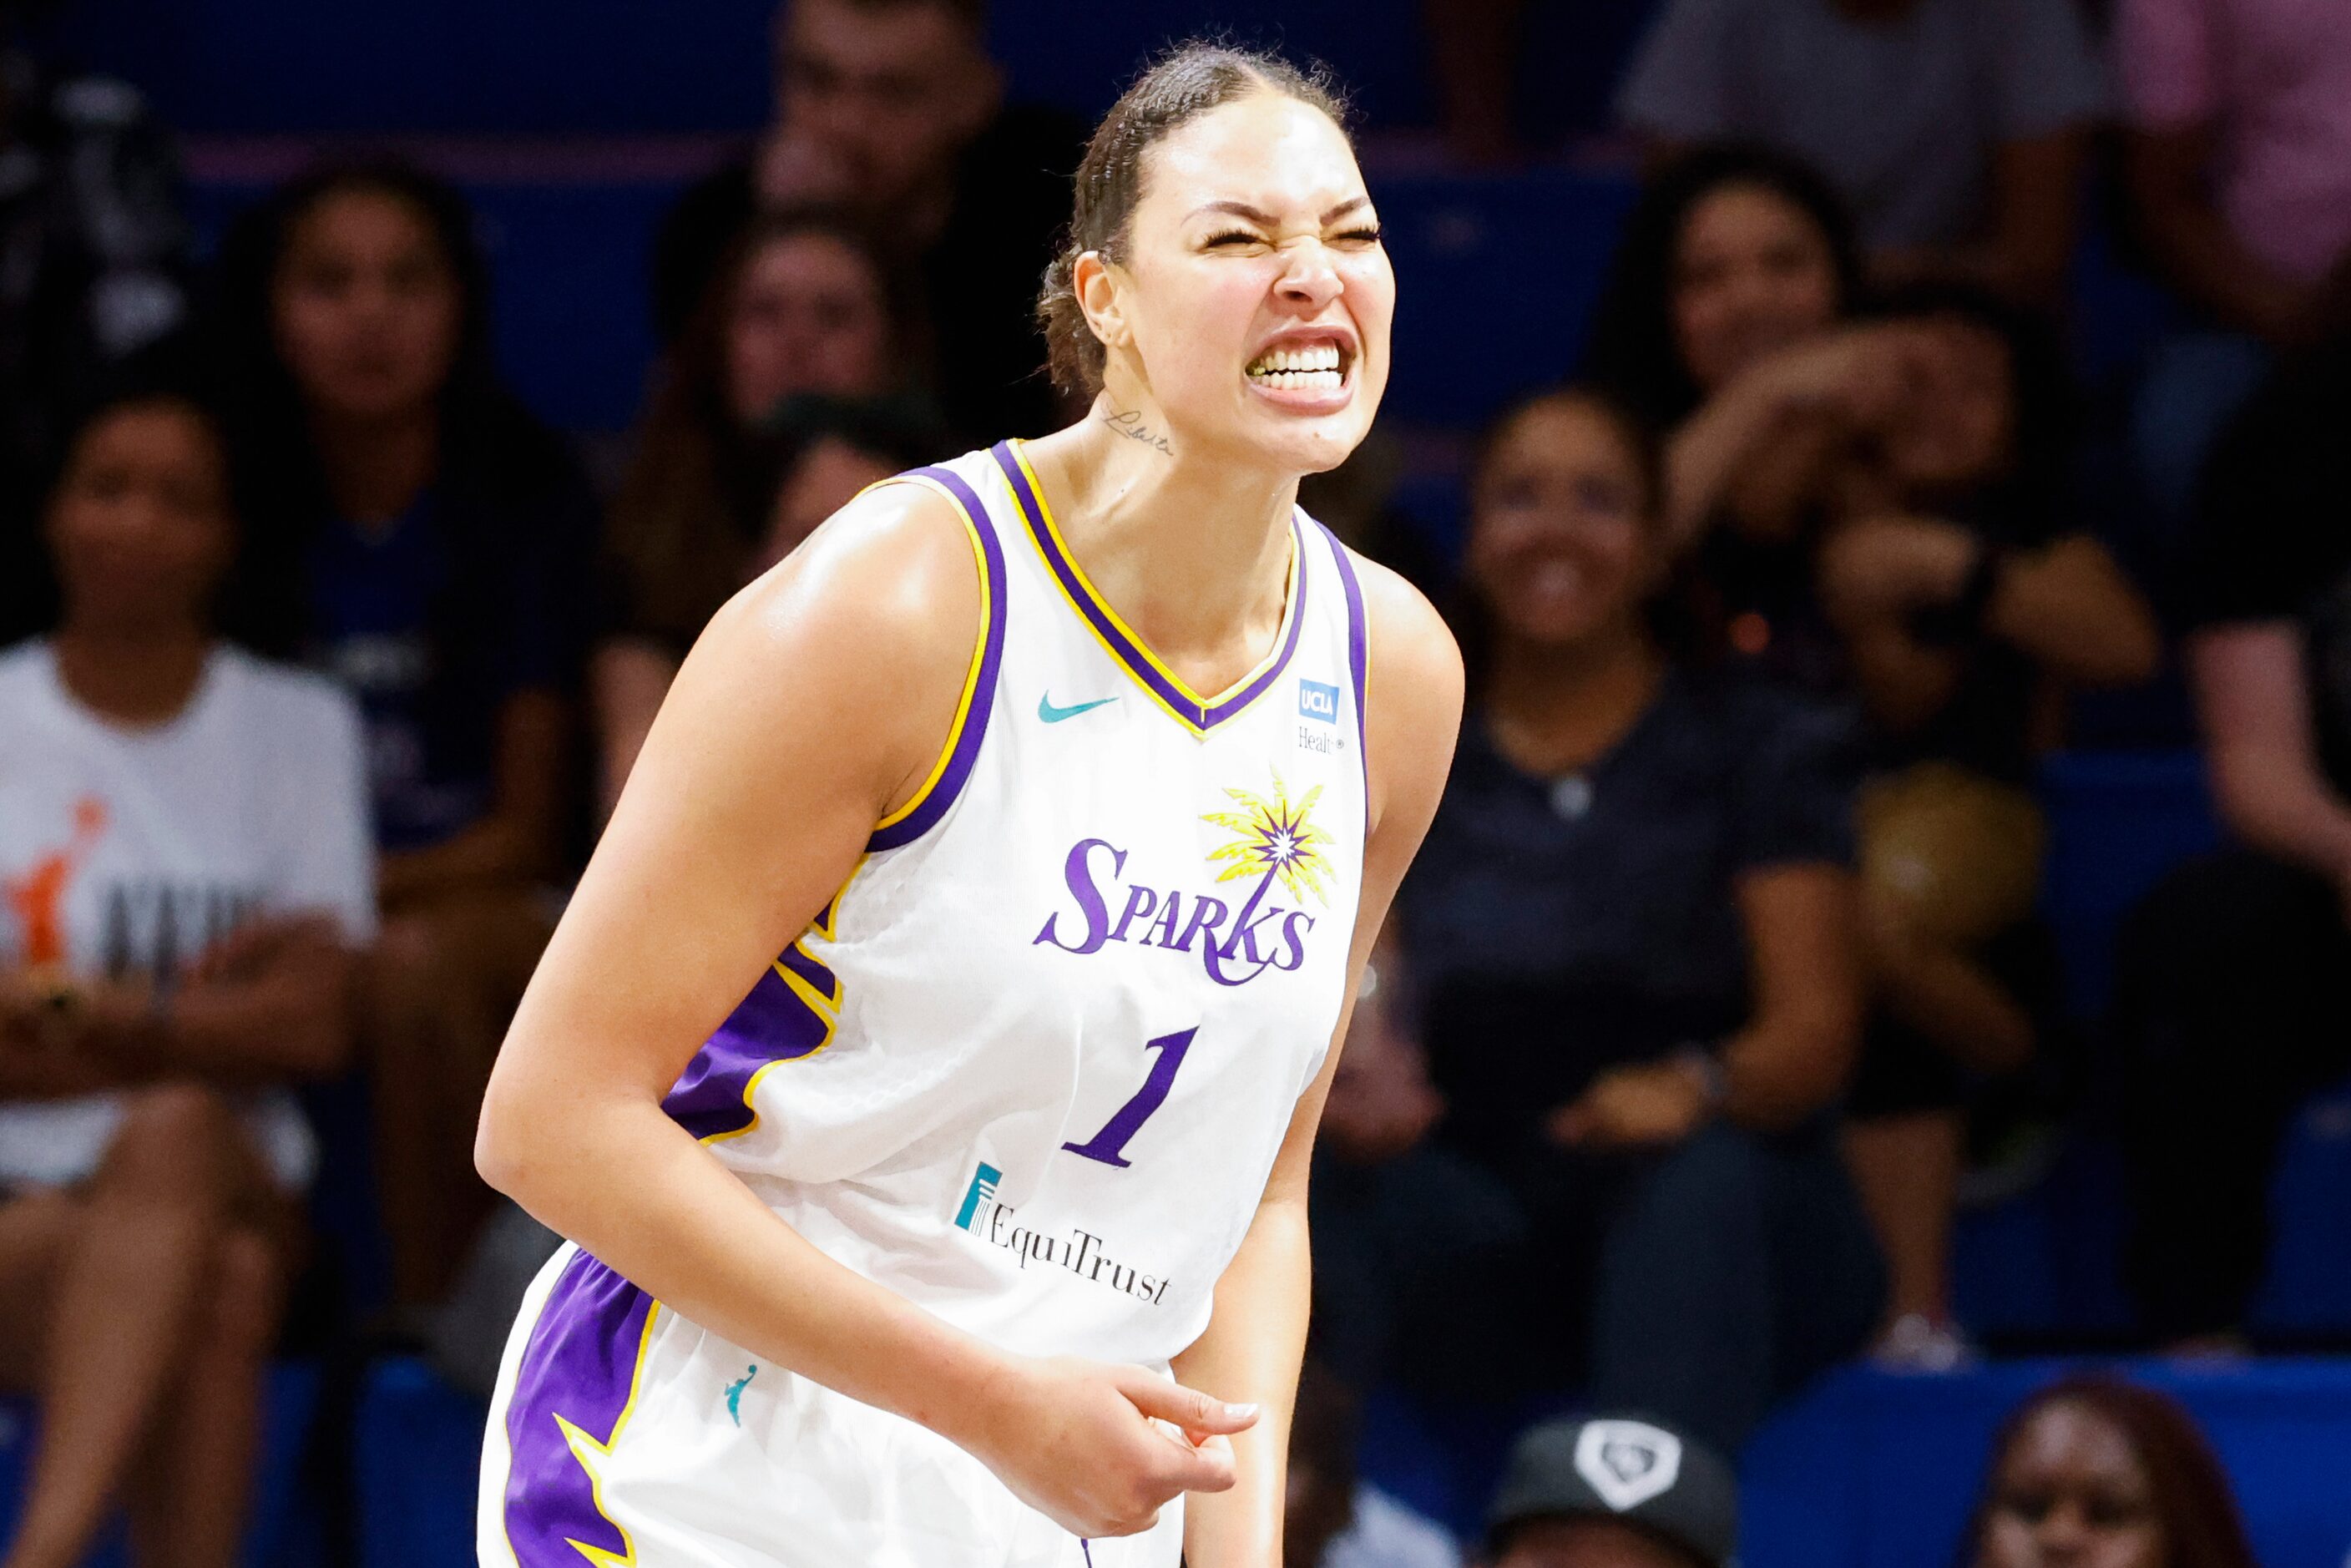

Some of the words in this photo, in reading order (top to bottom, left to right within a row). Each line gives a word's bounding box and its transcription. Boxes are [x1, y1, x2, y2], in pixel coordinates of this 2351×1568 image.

[1301, 689, 1333, 716] UCLA
[1060, 1024, 1201, 1168] 1
[989, 1202, 1172, 1306] EquiTrust
